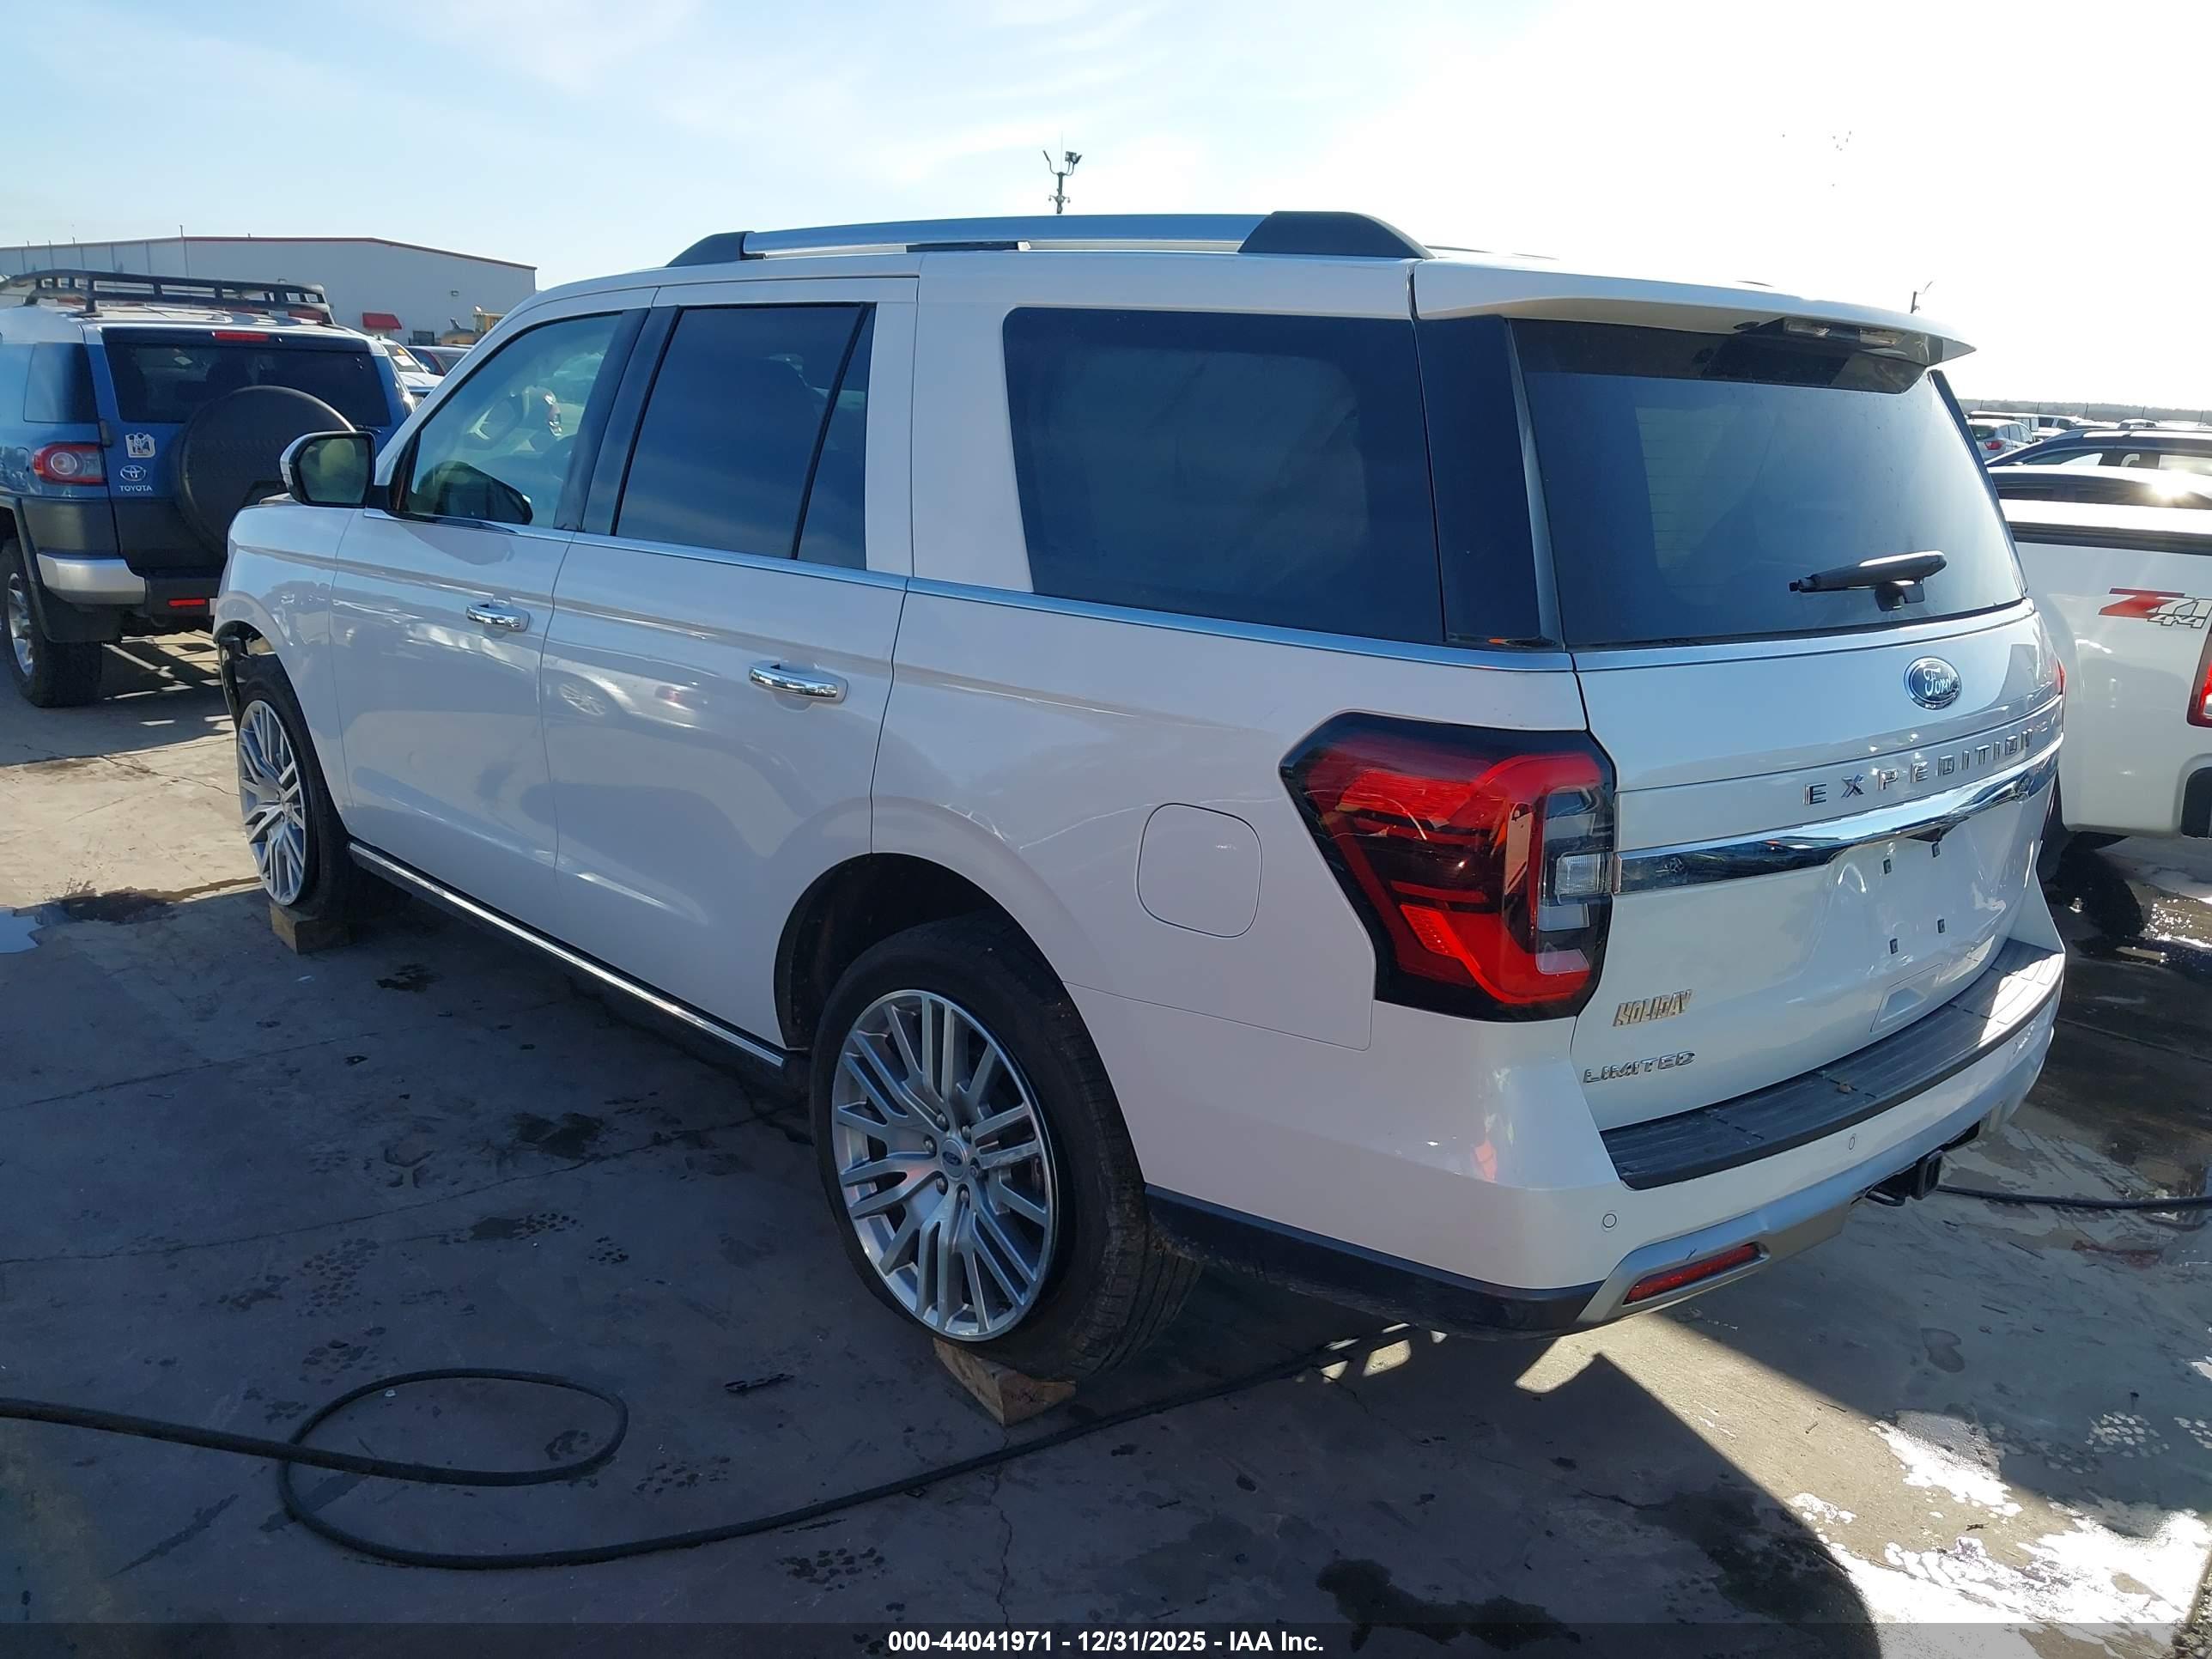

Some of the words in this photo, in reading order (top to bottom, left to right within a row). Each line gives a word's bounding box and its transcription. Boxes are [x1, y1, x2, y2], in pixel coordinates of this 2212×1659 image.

[2098, 587, 2212, 618] Z71
[1923, 667, 1954, 696] Ford
[1803, 728, 2033, 805] EXPEDITION
[1613, 988, 1692, 1027] HOLIDAY
[1583, 1050, 1696, 1084] LIMITED
